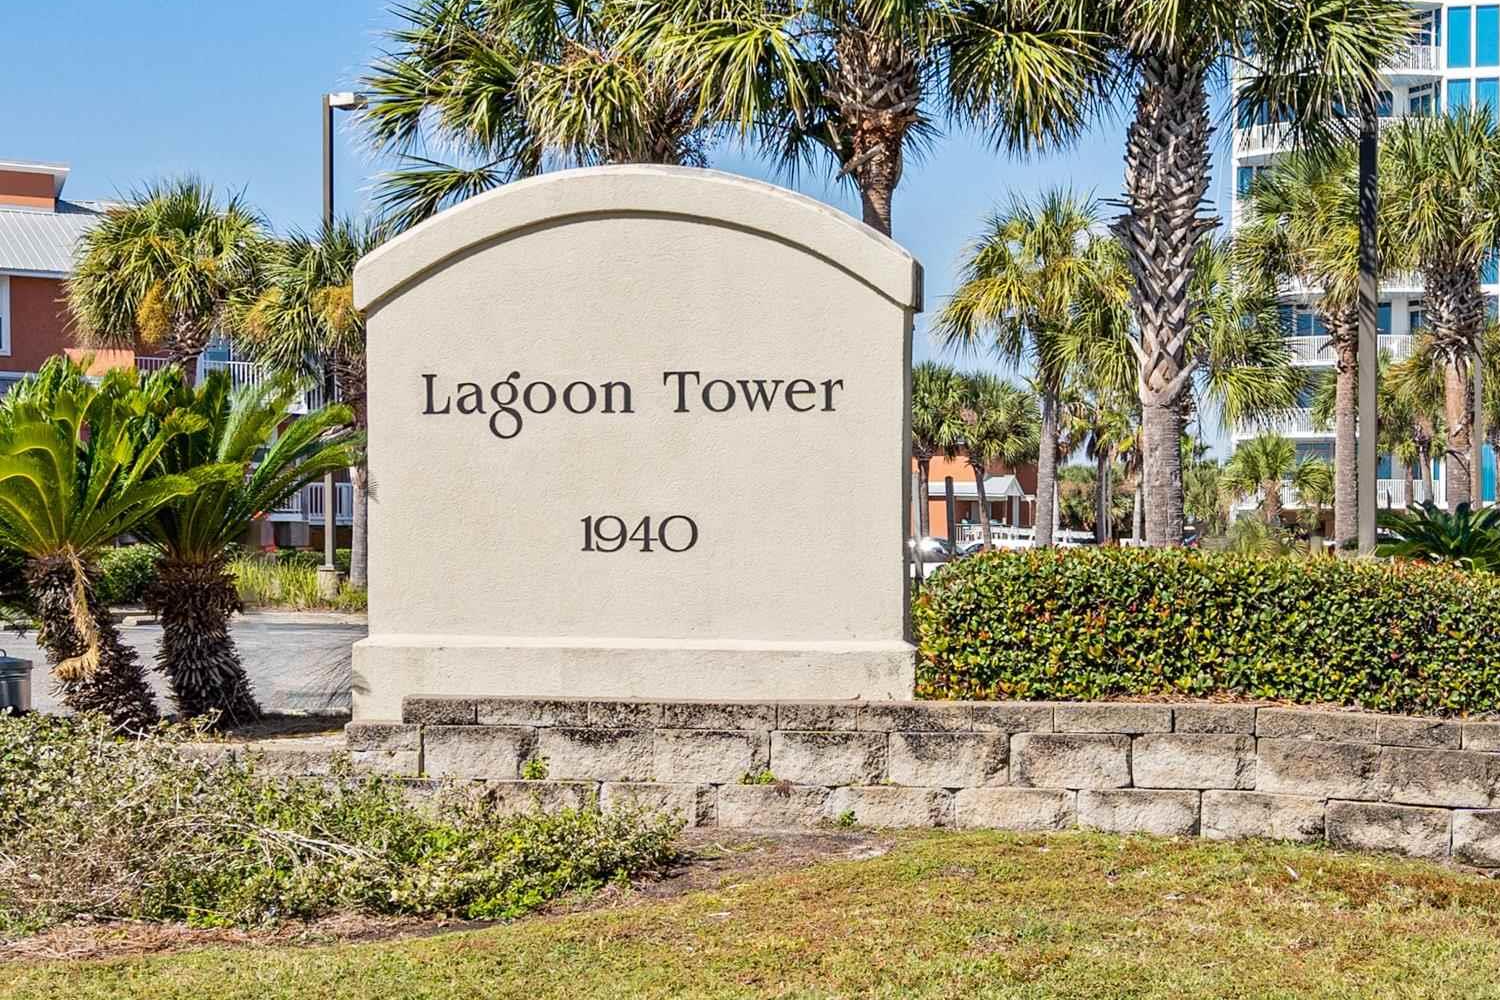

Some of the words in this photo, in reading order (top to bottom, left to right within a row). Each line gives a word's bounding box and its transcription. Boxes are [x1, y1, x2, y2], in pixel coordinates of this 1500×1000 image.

[421, 370, 635, 440] Lagoon
[663, 370, 844, 413] Tower
[580, 514, 699, 553] 1940
